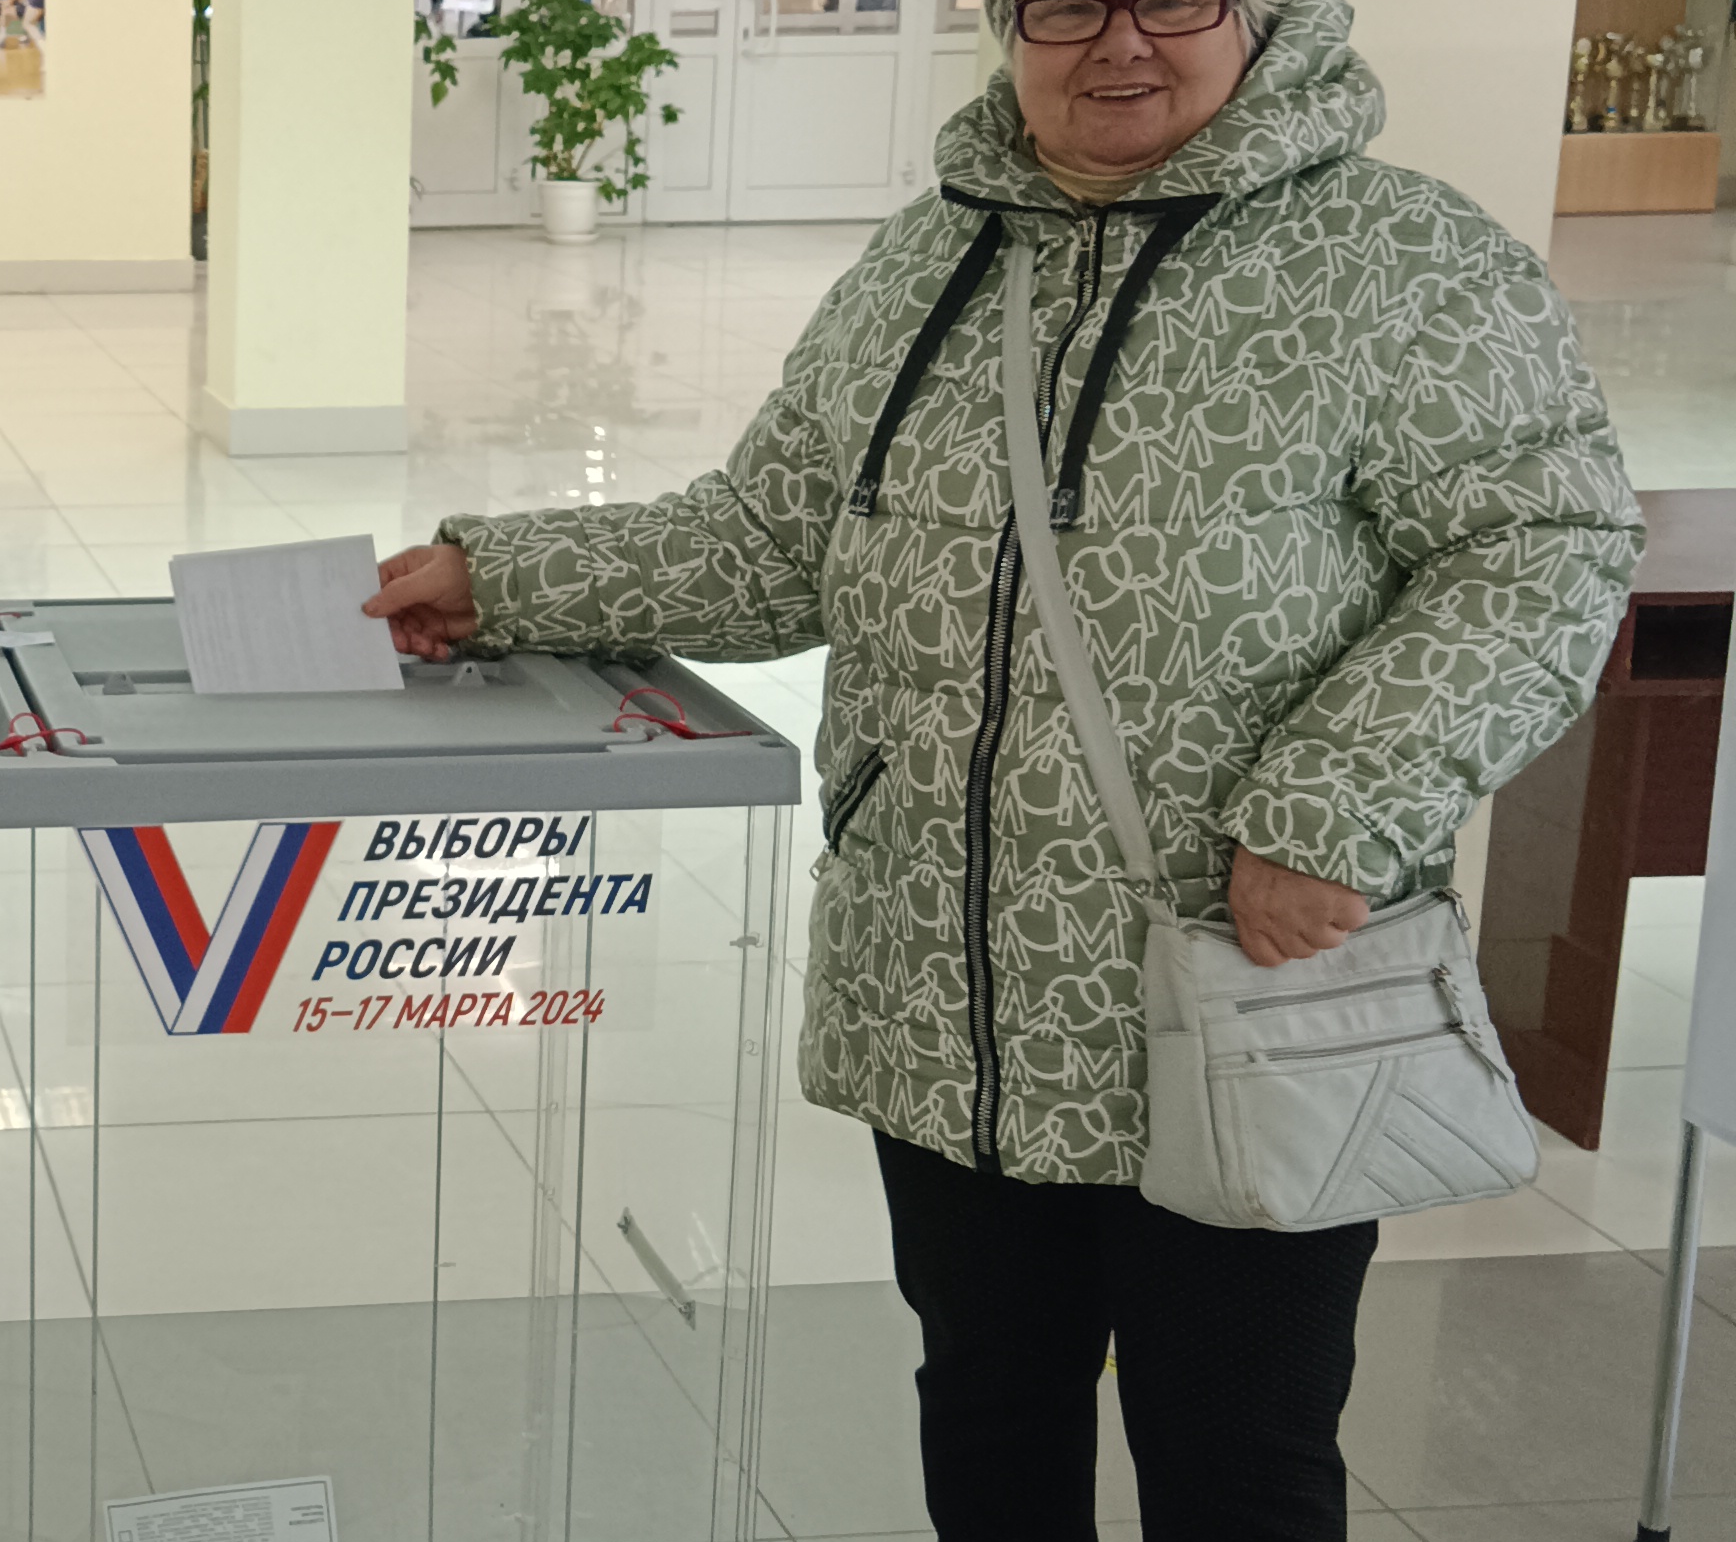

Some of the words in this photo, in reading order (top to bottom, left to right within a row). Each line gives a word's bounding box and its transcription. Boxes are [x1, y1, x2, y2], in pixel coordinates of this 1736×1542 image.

[363, 815, 590, 862] ВЫБОРЫ
[337, 873, 653, 924] ПРЕЗИДЕНТА
[311, 936, 516, 981] РОССИИ
[393, 992, 515, 1029] МАРТА
[519, 989, 605, 1026] 2024
